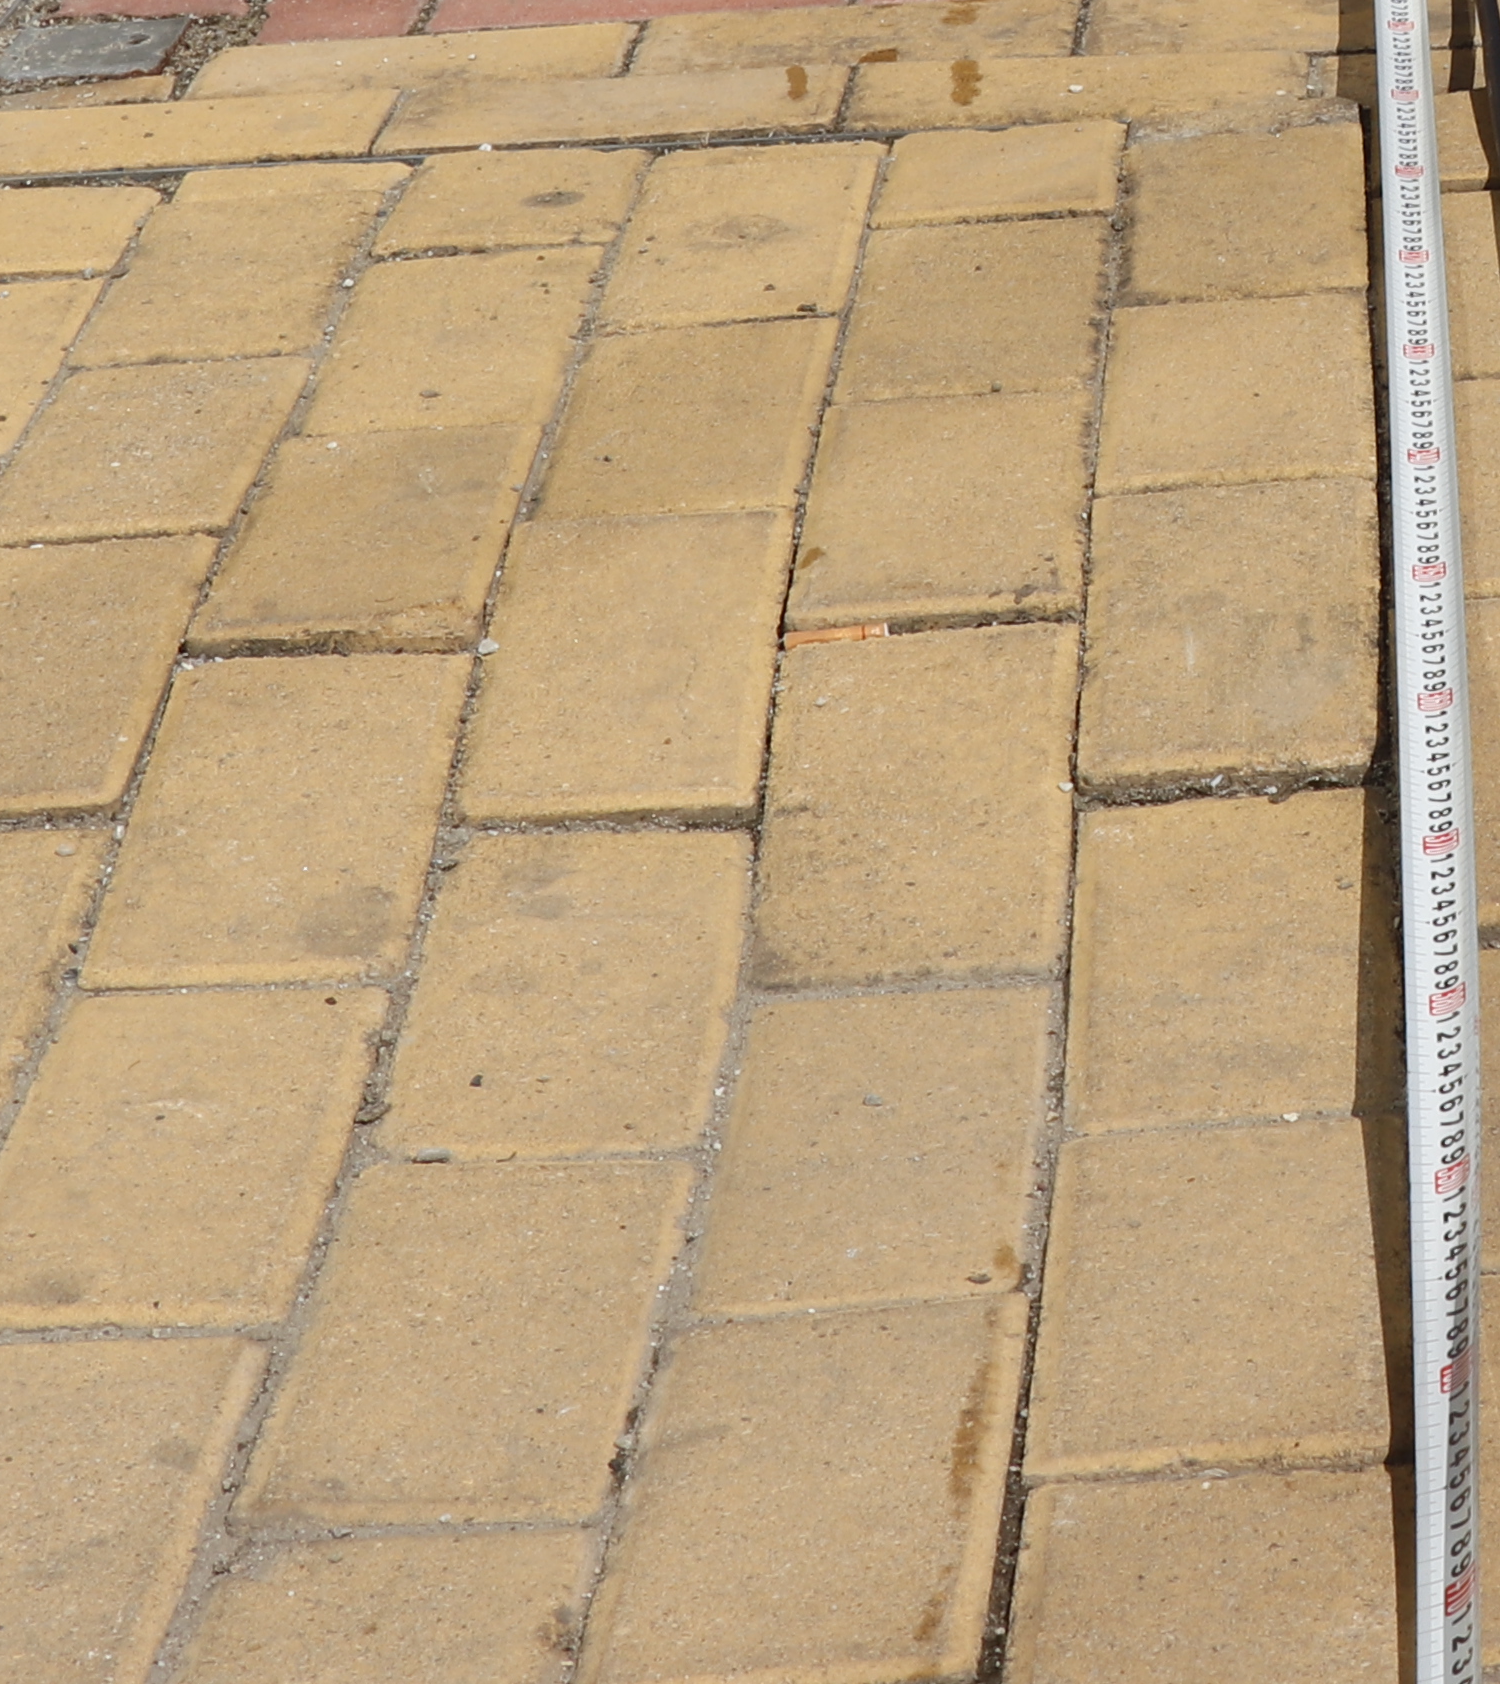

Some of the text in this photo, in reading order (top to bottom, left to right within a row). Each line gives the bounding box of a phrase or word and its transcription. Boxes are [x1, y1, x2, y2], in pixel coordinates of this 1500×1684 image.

[1419, 593, 1442, 602] 2
[1420, 605, 1443, 615] 3
[1421, 619, 1443, 628] 4
[1421, 630, 1444, 641] 5
[1422, 643, 1445, 654] 6
[1423, 655, 1445, 665] 7
[1423, 669, 1446, 680] 8
[1423, 681, 1447, 692] 9
[1425, 710, 1448, 718] 1
[1425, 723, 1449, 734] 2
[1425, 736, 1450, 748] 3
[1427, 752, 1450, 763] 4
[1427, 764, 1451, 776] 5
[1427, 779, 1451, 791] 6
[1428, 791, 1452, 803] 7
[1428, 807, 1453, 820] 8
[1429, 820, 1453, 833] 9
[1431, 853, 1454, 863] 1
[1430, 866, 1455, 880] 2
[1431, 881, 1456, 896] 3
[1432, 899, 1456, 912] 4
[1432, 912, 1457, 927] 5
[1433, 929, 1458, 943] 6
[1434, 943, 1458, 956] 7
[1434, 960, 1459, 975] 8
[1434, 975, 1459, 990] 9
[1436, 1011, 1460, 1023] 1
[1436, 1026, 1461, 1043] 2
[1437, 1042, 1462, 1060] 3
[1438, 1062, 1462, 1077] 4
[1438, 1076, 1463, 1095] 5
[1439, 1094, 1464, 1112] 6
[1440, 1110, 1464, 1126] 7
[1440, 1129, 1465, 1148] 8
[1441, 1145, 1468, 1165] 9
[1443, 1185, 1466, 1202] 1
[1443, 1202, 1467, 1224] 2
[1443, 1220, 1468, 1242] 3
[1444, 1242, 1468, 1261] 4
[1444, 1256, 1469, 1281] 5
[1445, 1277, 1469, 1301] 6
[1446, 1295, 1469, 1317] 7
[1446, 1316, 1469, 1341] 8
[1447, 1335, 1469, 1359] 9
[1449, 1381, 1469, 1402] 1
[1449, 1400, 1469, 1427] 2
[1448, 1421, 1470, 1446] 3
[1449, 1446, 1470, 1468] 4
[1449, 1464, 1470, 1490] 5
[1449, 1486, 1471, 1512] 6
[1450, 1507, 1471, 1530] 7
[1450, 1530, 1471, 1557] 8
[1451, 1551, 1472, 1578] 9
[1452, 1601, 1472, 1626] 1
[1452, 1624, 1472, 1653] 2
[1451, 1647, 1473, 1676] 3
